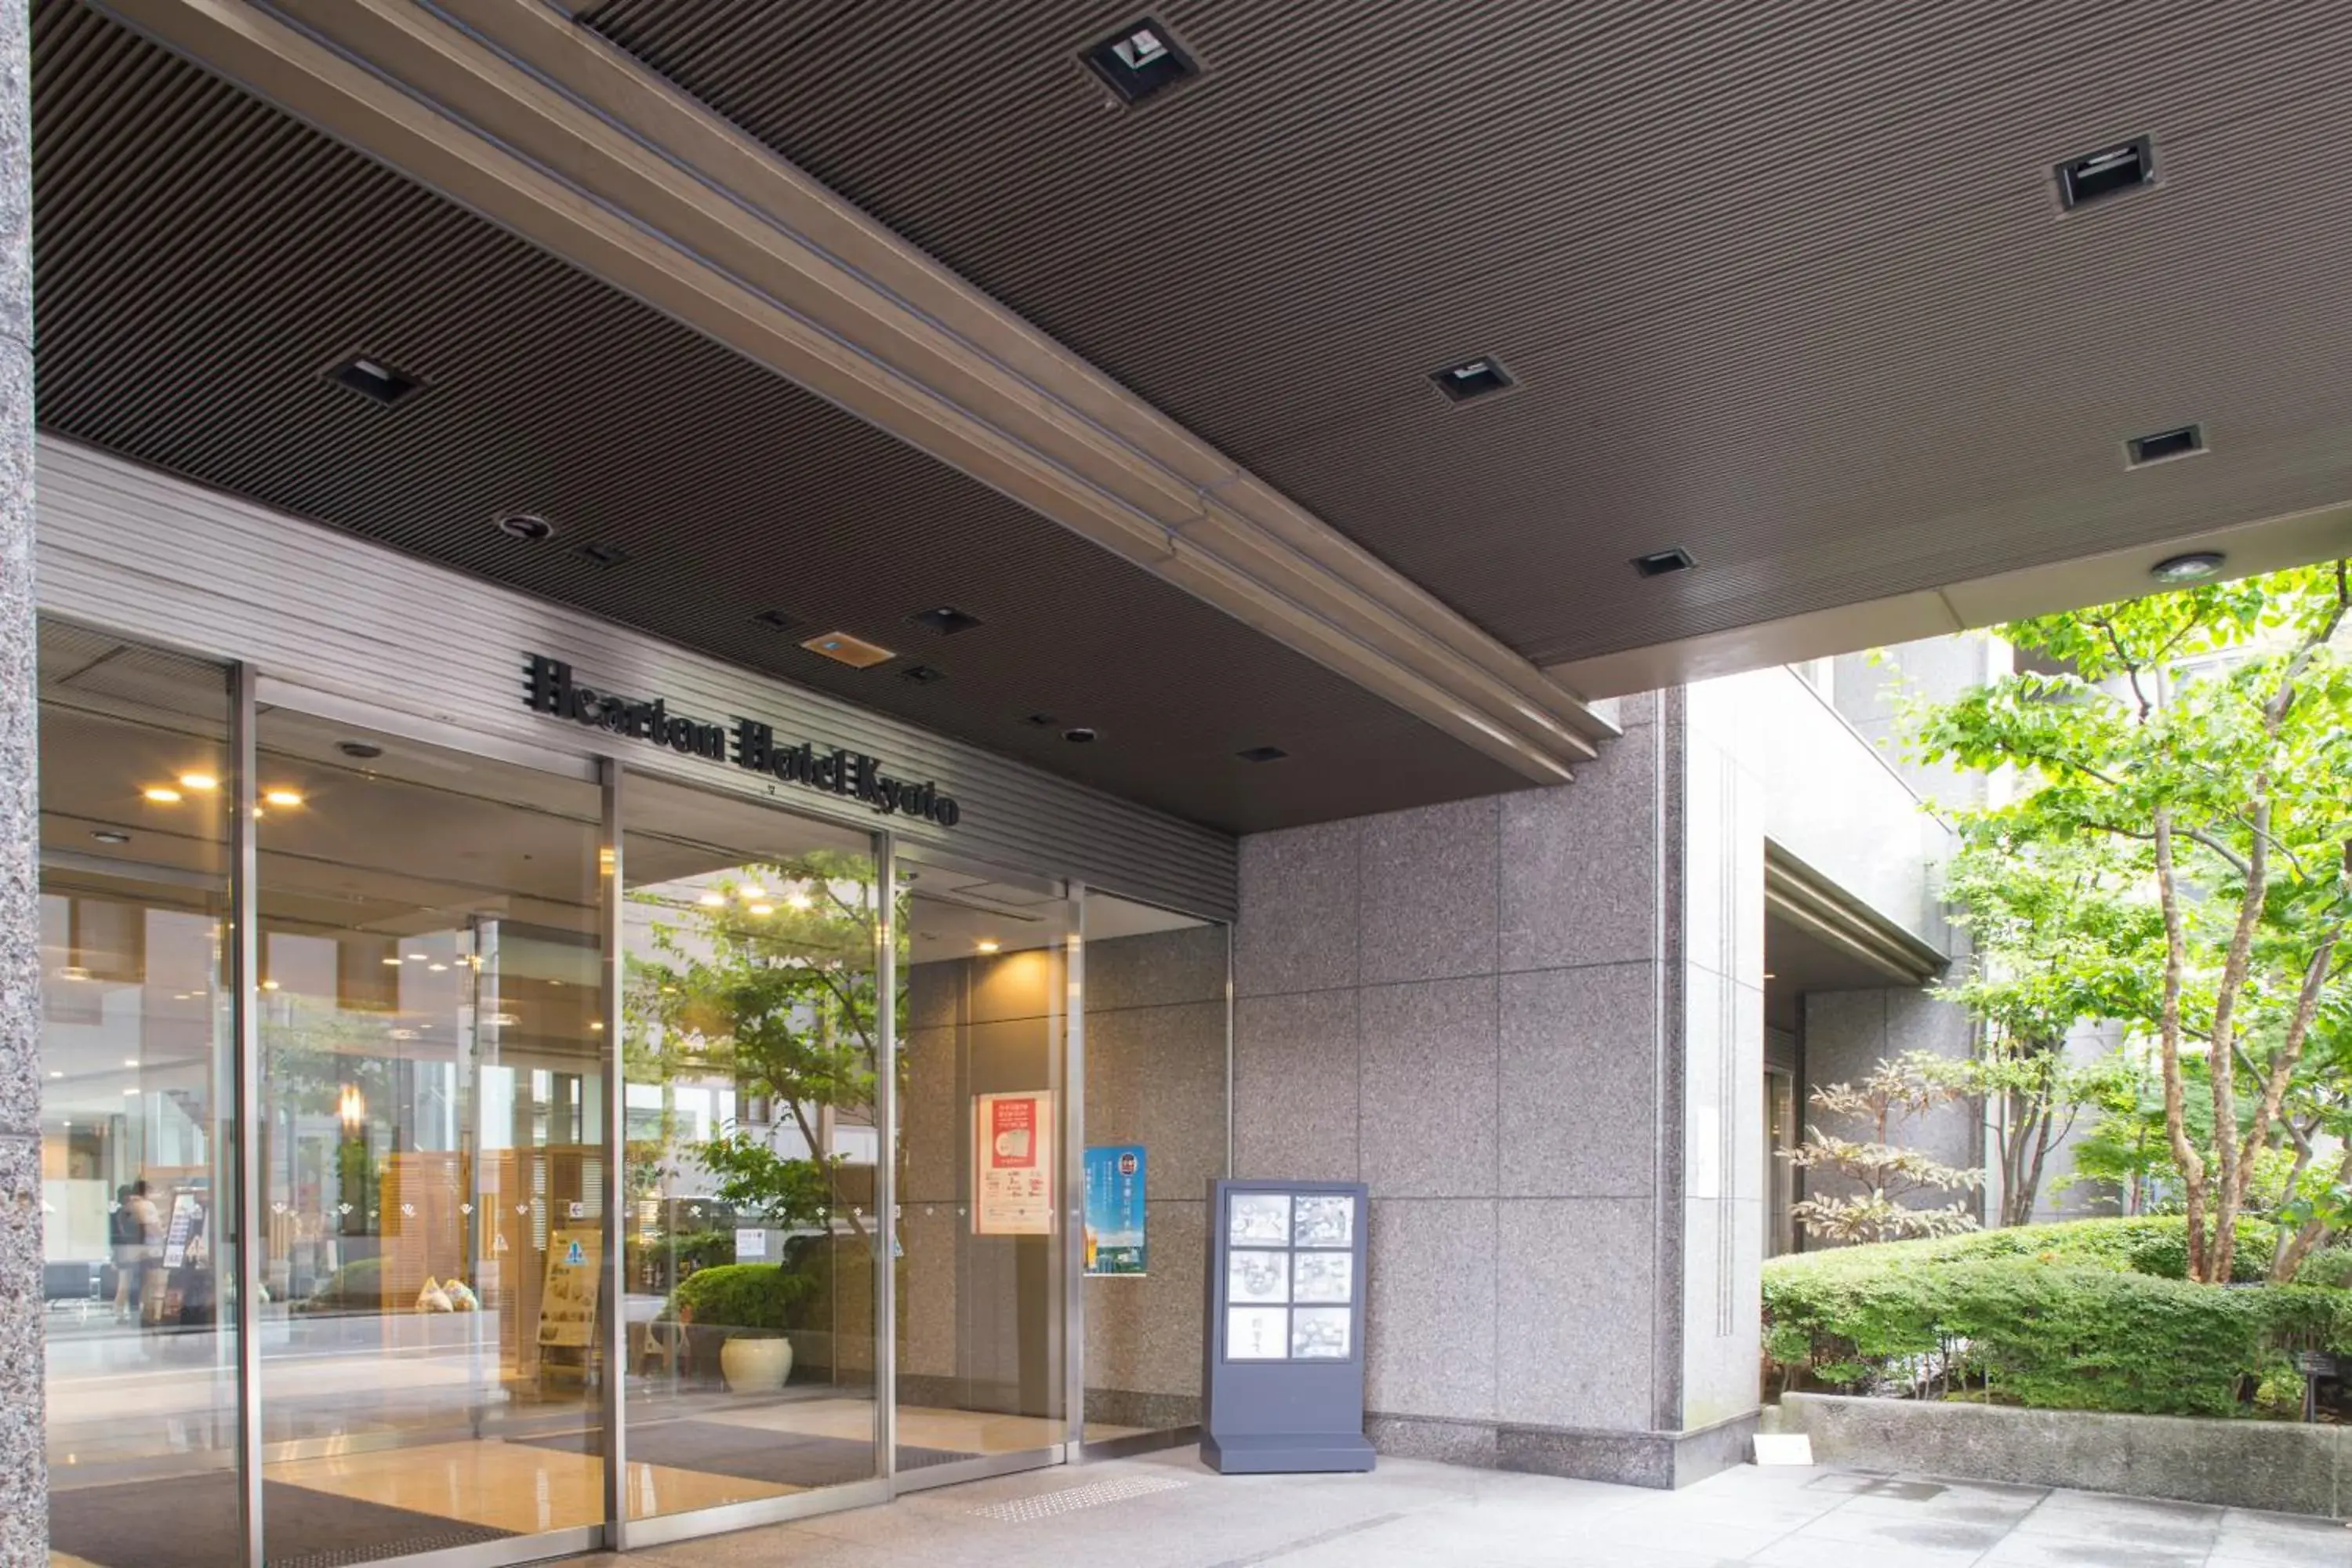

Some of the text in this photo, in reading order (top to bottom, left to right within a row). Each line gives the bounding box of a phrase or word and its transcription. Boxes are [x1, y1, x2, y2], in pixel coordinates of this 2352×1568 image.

[524, 652, 960, 826] Hearton Hotel Kyoto
